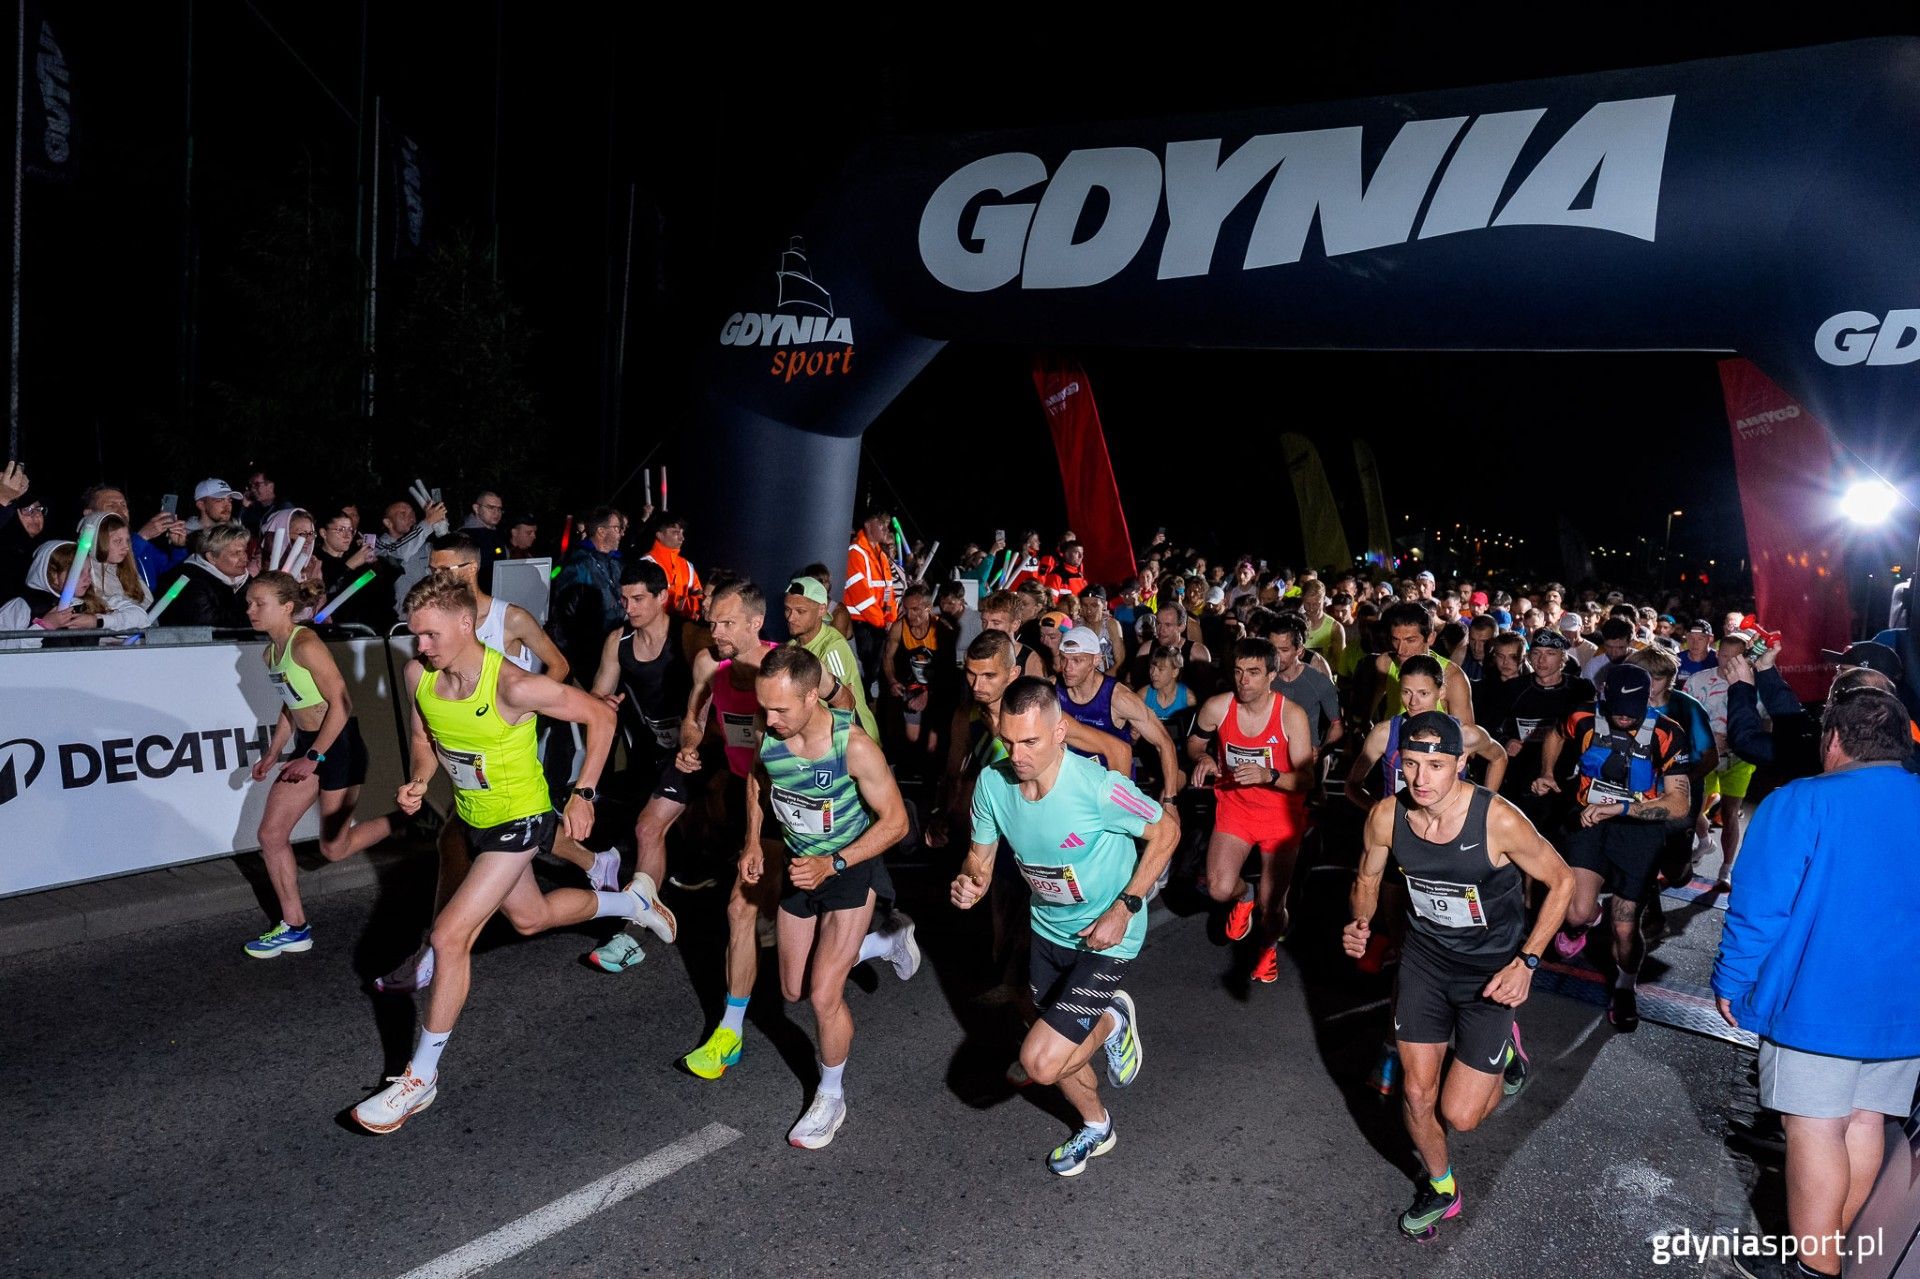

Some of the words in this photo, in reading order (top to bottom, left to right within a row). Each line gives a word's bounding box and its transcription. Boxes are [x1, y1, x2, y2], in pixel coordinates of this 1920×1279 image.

[918, 94, 1676, 292] GDYNIA
[719, 312, 854, 347] GDYNIA
[770, 346, 855, 384] sport
[743, 728, 752, 738] 5
[450, 763, 458, 775] 3
[819, 773, 829, 785] 7
[792, 809, 801, 819] 4
[1429, 898, 1448, 912] 19
